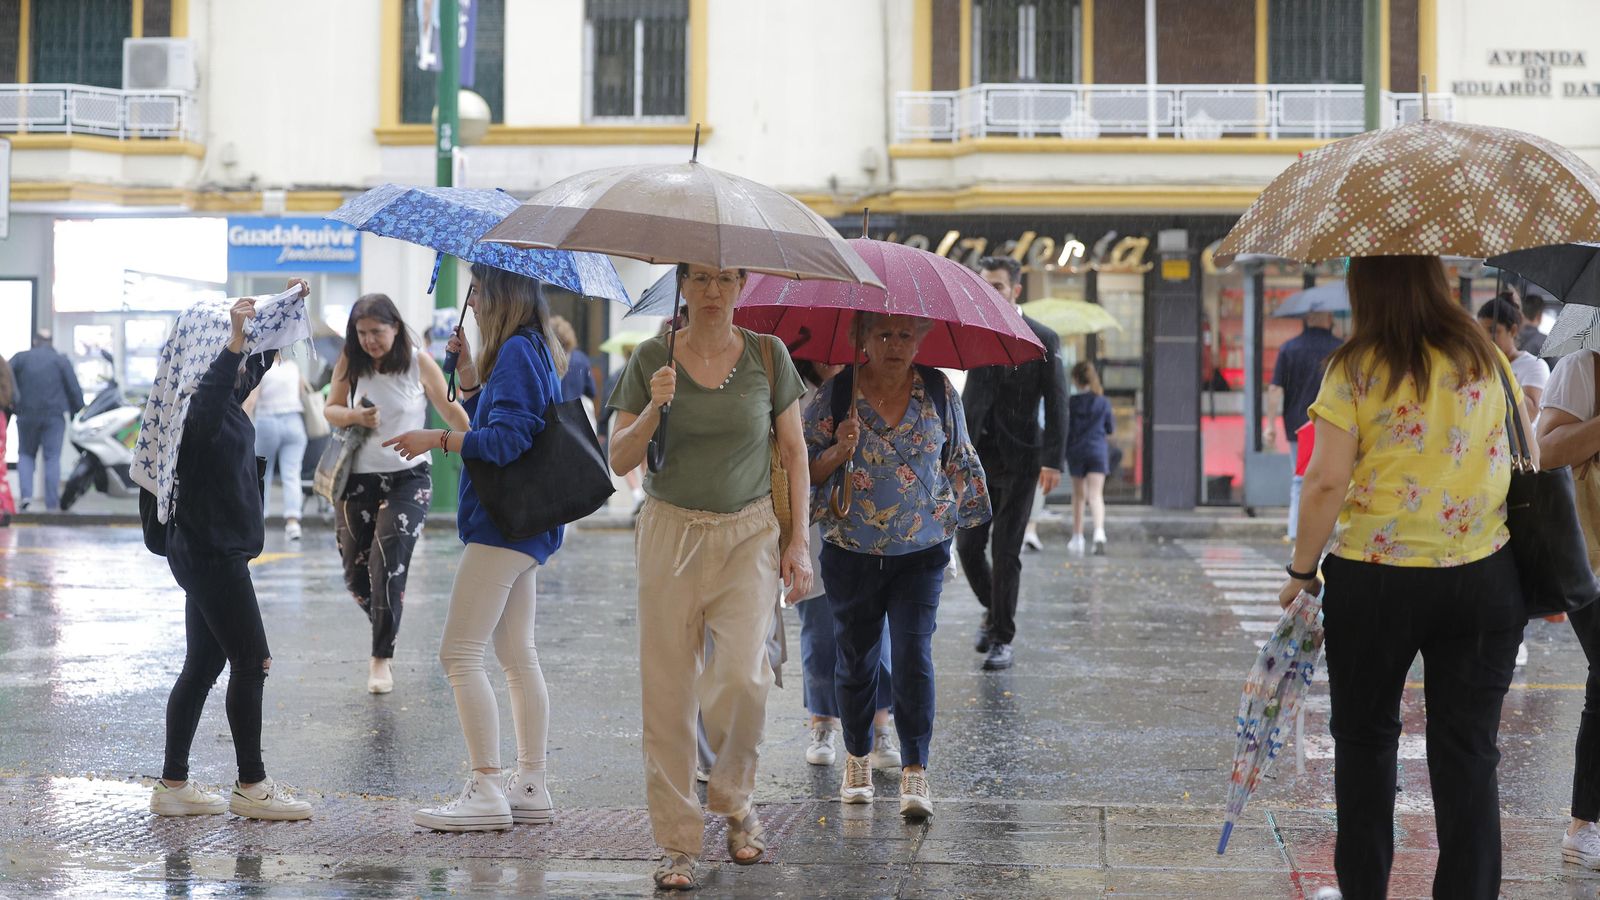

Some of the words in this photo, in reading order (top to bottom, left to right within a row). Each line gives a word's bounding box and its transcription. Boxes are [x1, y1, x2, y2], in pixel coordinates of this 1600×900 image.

[1489, 50, 1586, 66] AVENIDA
[1525, 67, 1551, 81] DE
[1453, 81, 1552, 97] EDUARDO
[229, 225, 355, 248] Guadalquivir
